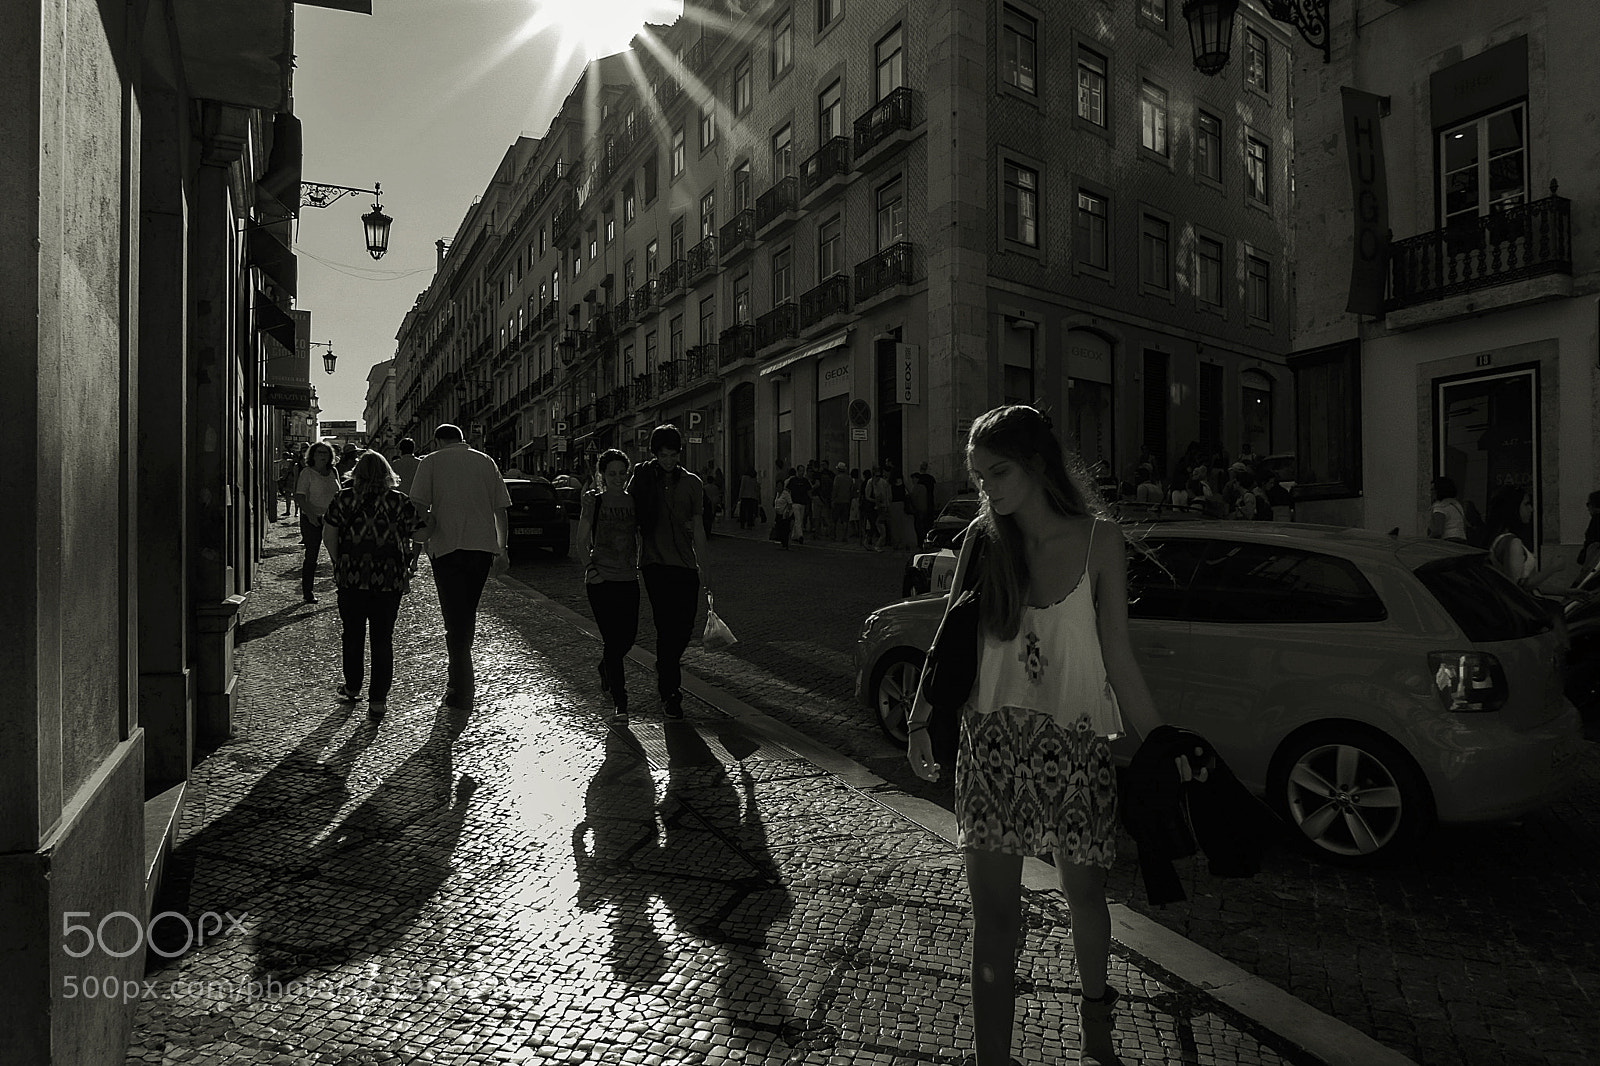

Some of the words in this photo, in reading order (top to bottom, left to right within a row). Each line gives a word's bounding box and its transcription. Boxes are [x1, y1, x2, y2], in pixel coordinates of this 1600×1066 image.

[1354, 115, 1379, 263] HUGO
[1071, 346, 1104, 362] GEOX
[825, 365, 849, 381] GEOX
[904, 361, 912, 401] GEOX
[556, 422, 568, 435] P
[689, 412, 702, 430] P
